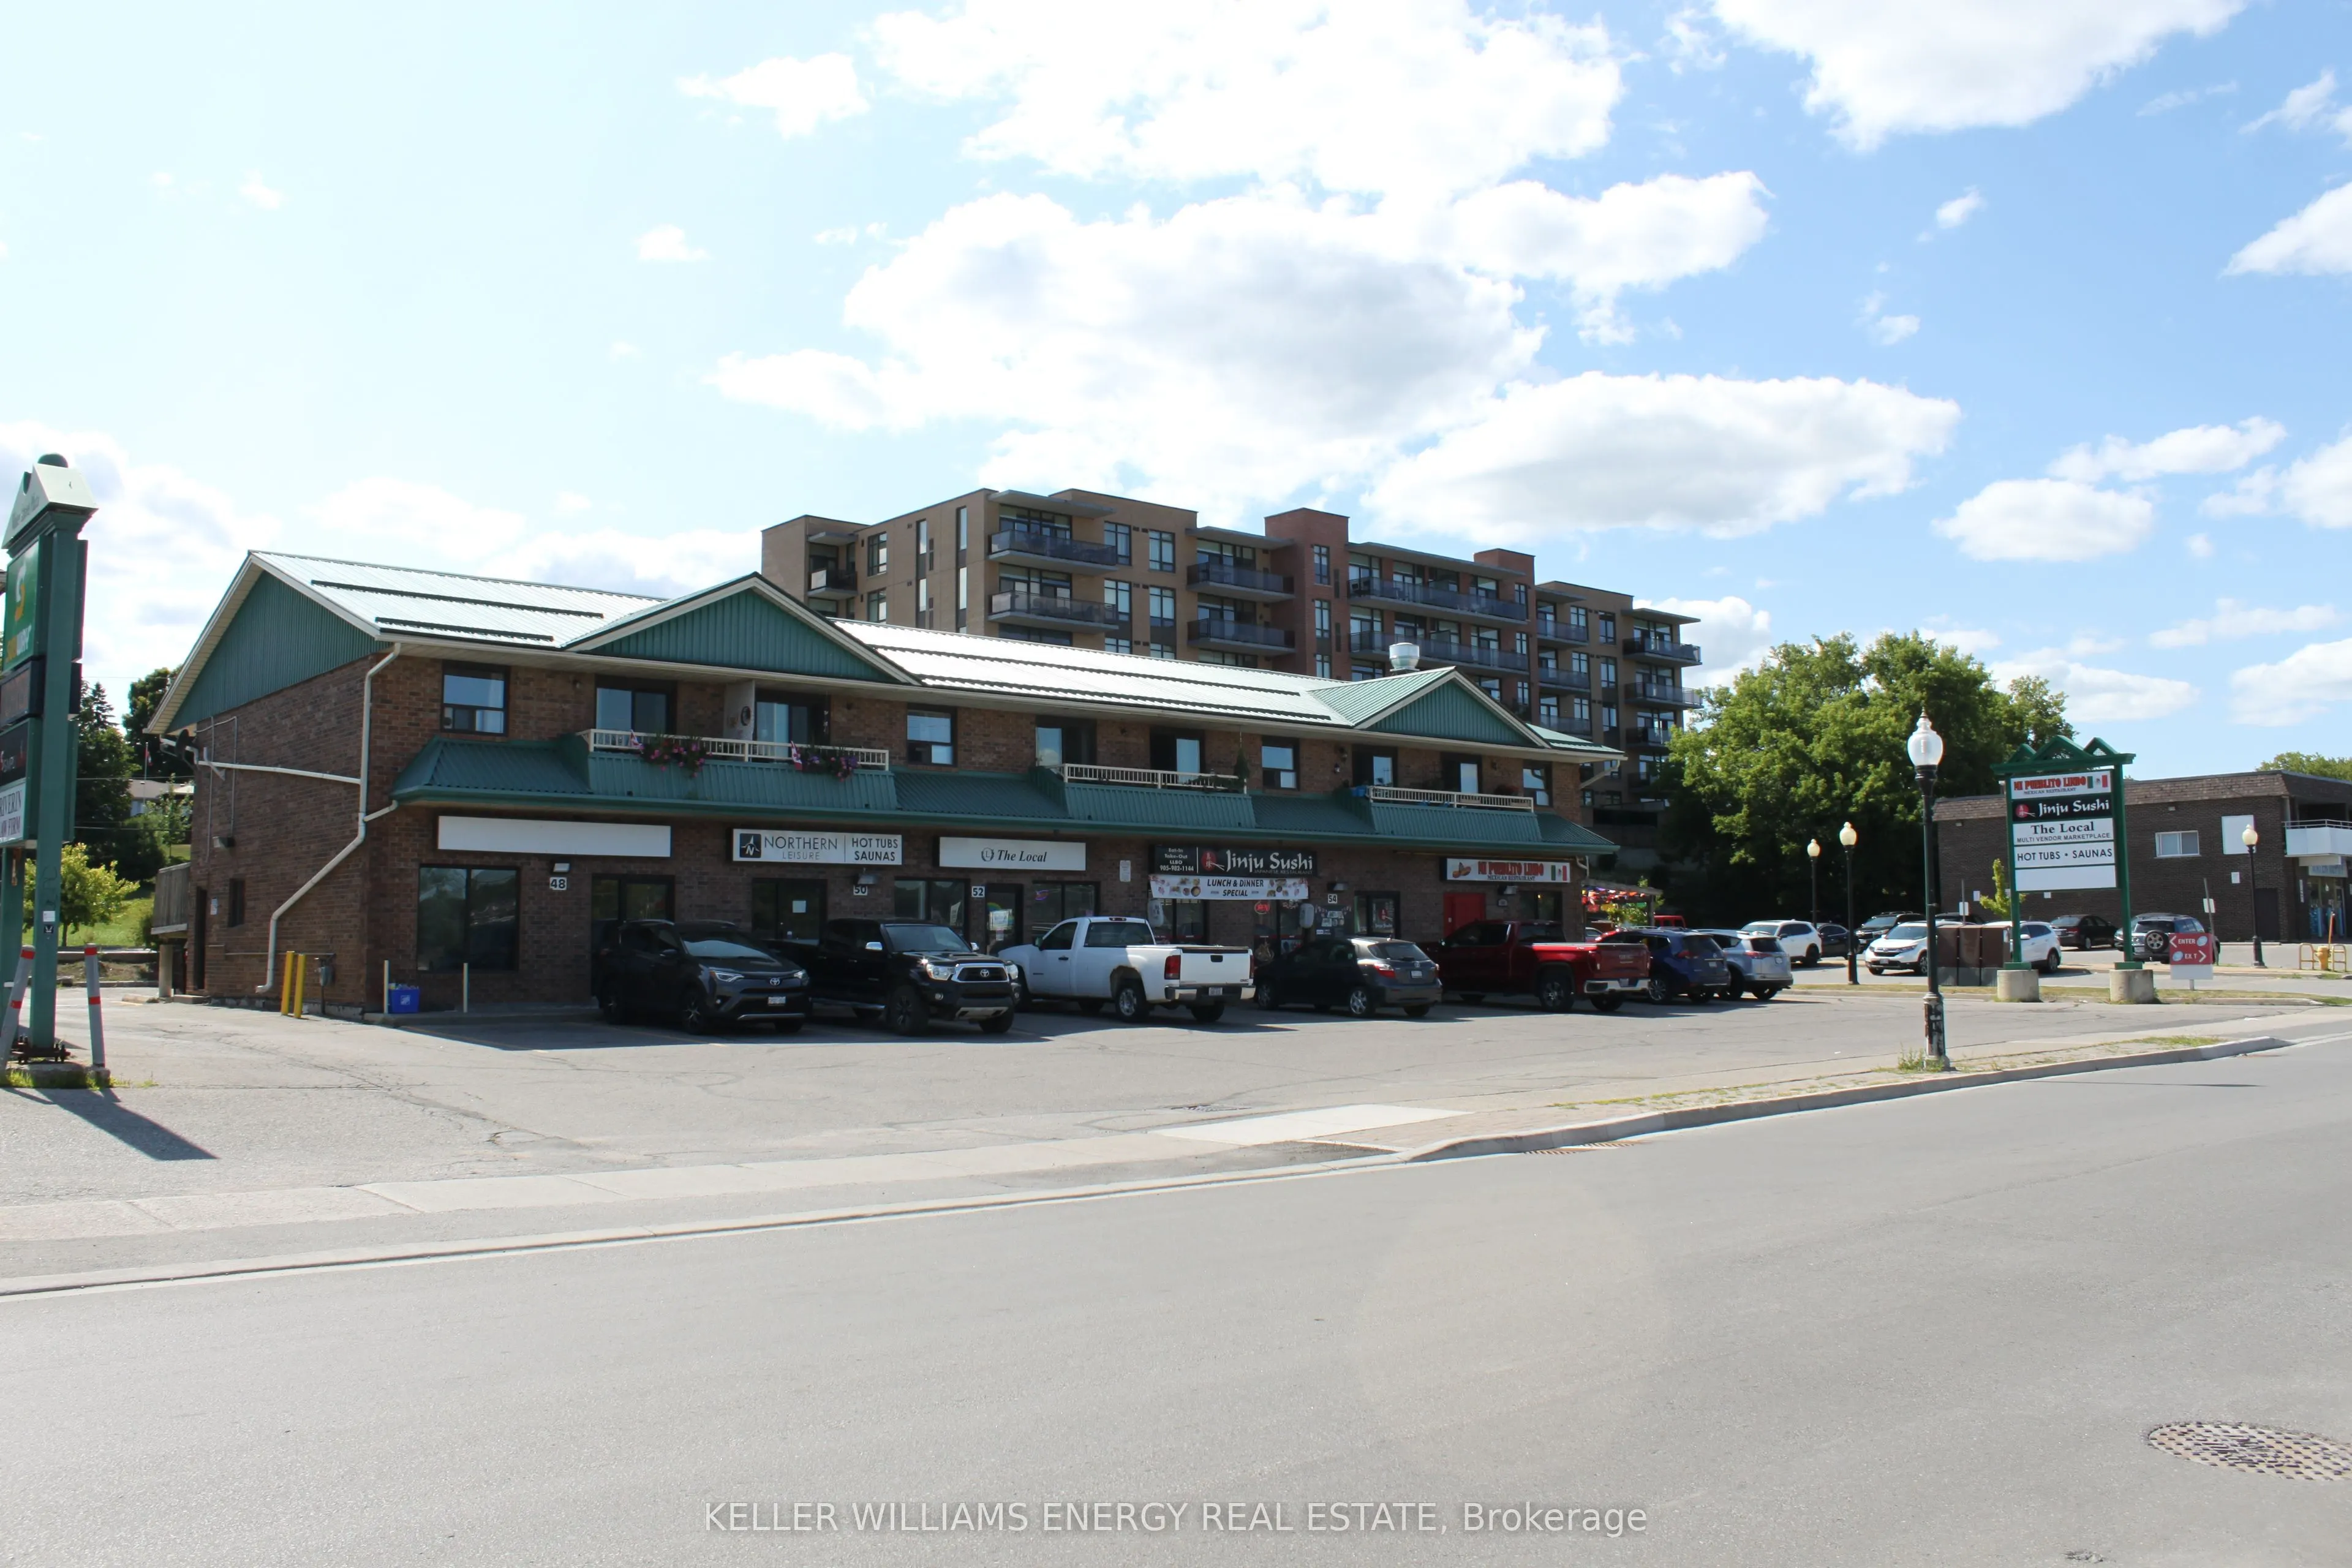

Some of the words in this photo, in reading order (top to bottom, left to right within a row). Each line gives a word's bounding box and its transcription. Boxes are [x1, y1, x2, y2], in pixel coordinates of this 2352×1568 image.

[2014, 781, 2023, 791] MI
[2024, 778, 2061, 790] PUEBLITO
[2063, 776, 2087, 787] LINDO
[2038, 802, 2068, 817] Jinju
[2073, 799, 2109, 813] Sushi
[2030, 824, 2055, 834] The
[2059, 821, 2095, 833] Local
[764, 836, 837, 850] NORTHERN
[852, 837, 873, 848] HOT
[875, 838, 898, 849] TUBS
[782, 851, 820, 861] LEISURE
[854, 851, 895, 861] SAUNAS
[997, 850, 1016, 861] The
[1019, 851, 1047, 862] Local
[2017, 852, 2036, 862] HOT
[2039, 851, 2060, 861] TUBS
[2072, 848, 2113, 859] SAUNAS
[1226, 850, 1264, 873] Jinju
[1270, 853, 1313, 870] Sushi
[1478, 861, 1487, 875] MI
[1524, 863, 1544, 876] LINDO
[551, 879, 565, 889] 48
[1207, 878, 1231, 887] LUNCH
[1240, 879, 1264, 888] DINNER
[854, 886, 867, 894] 50
